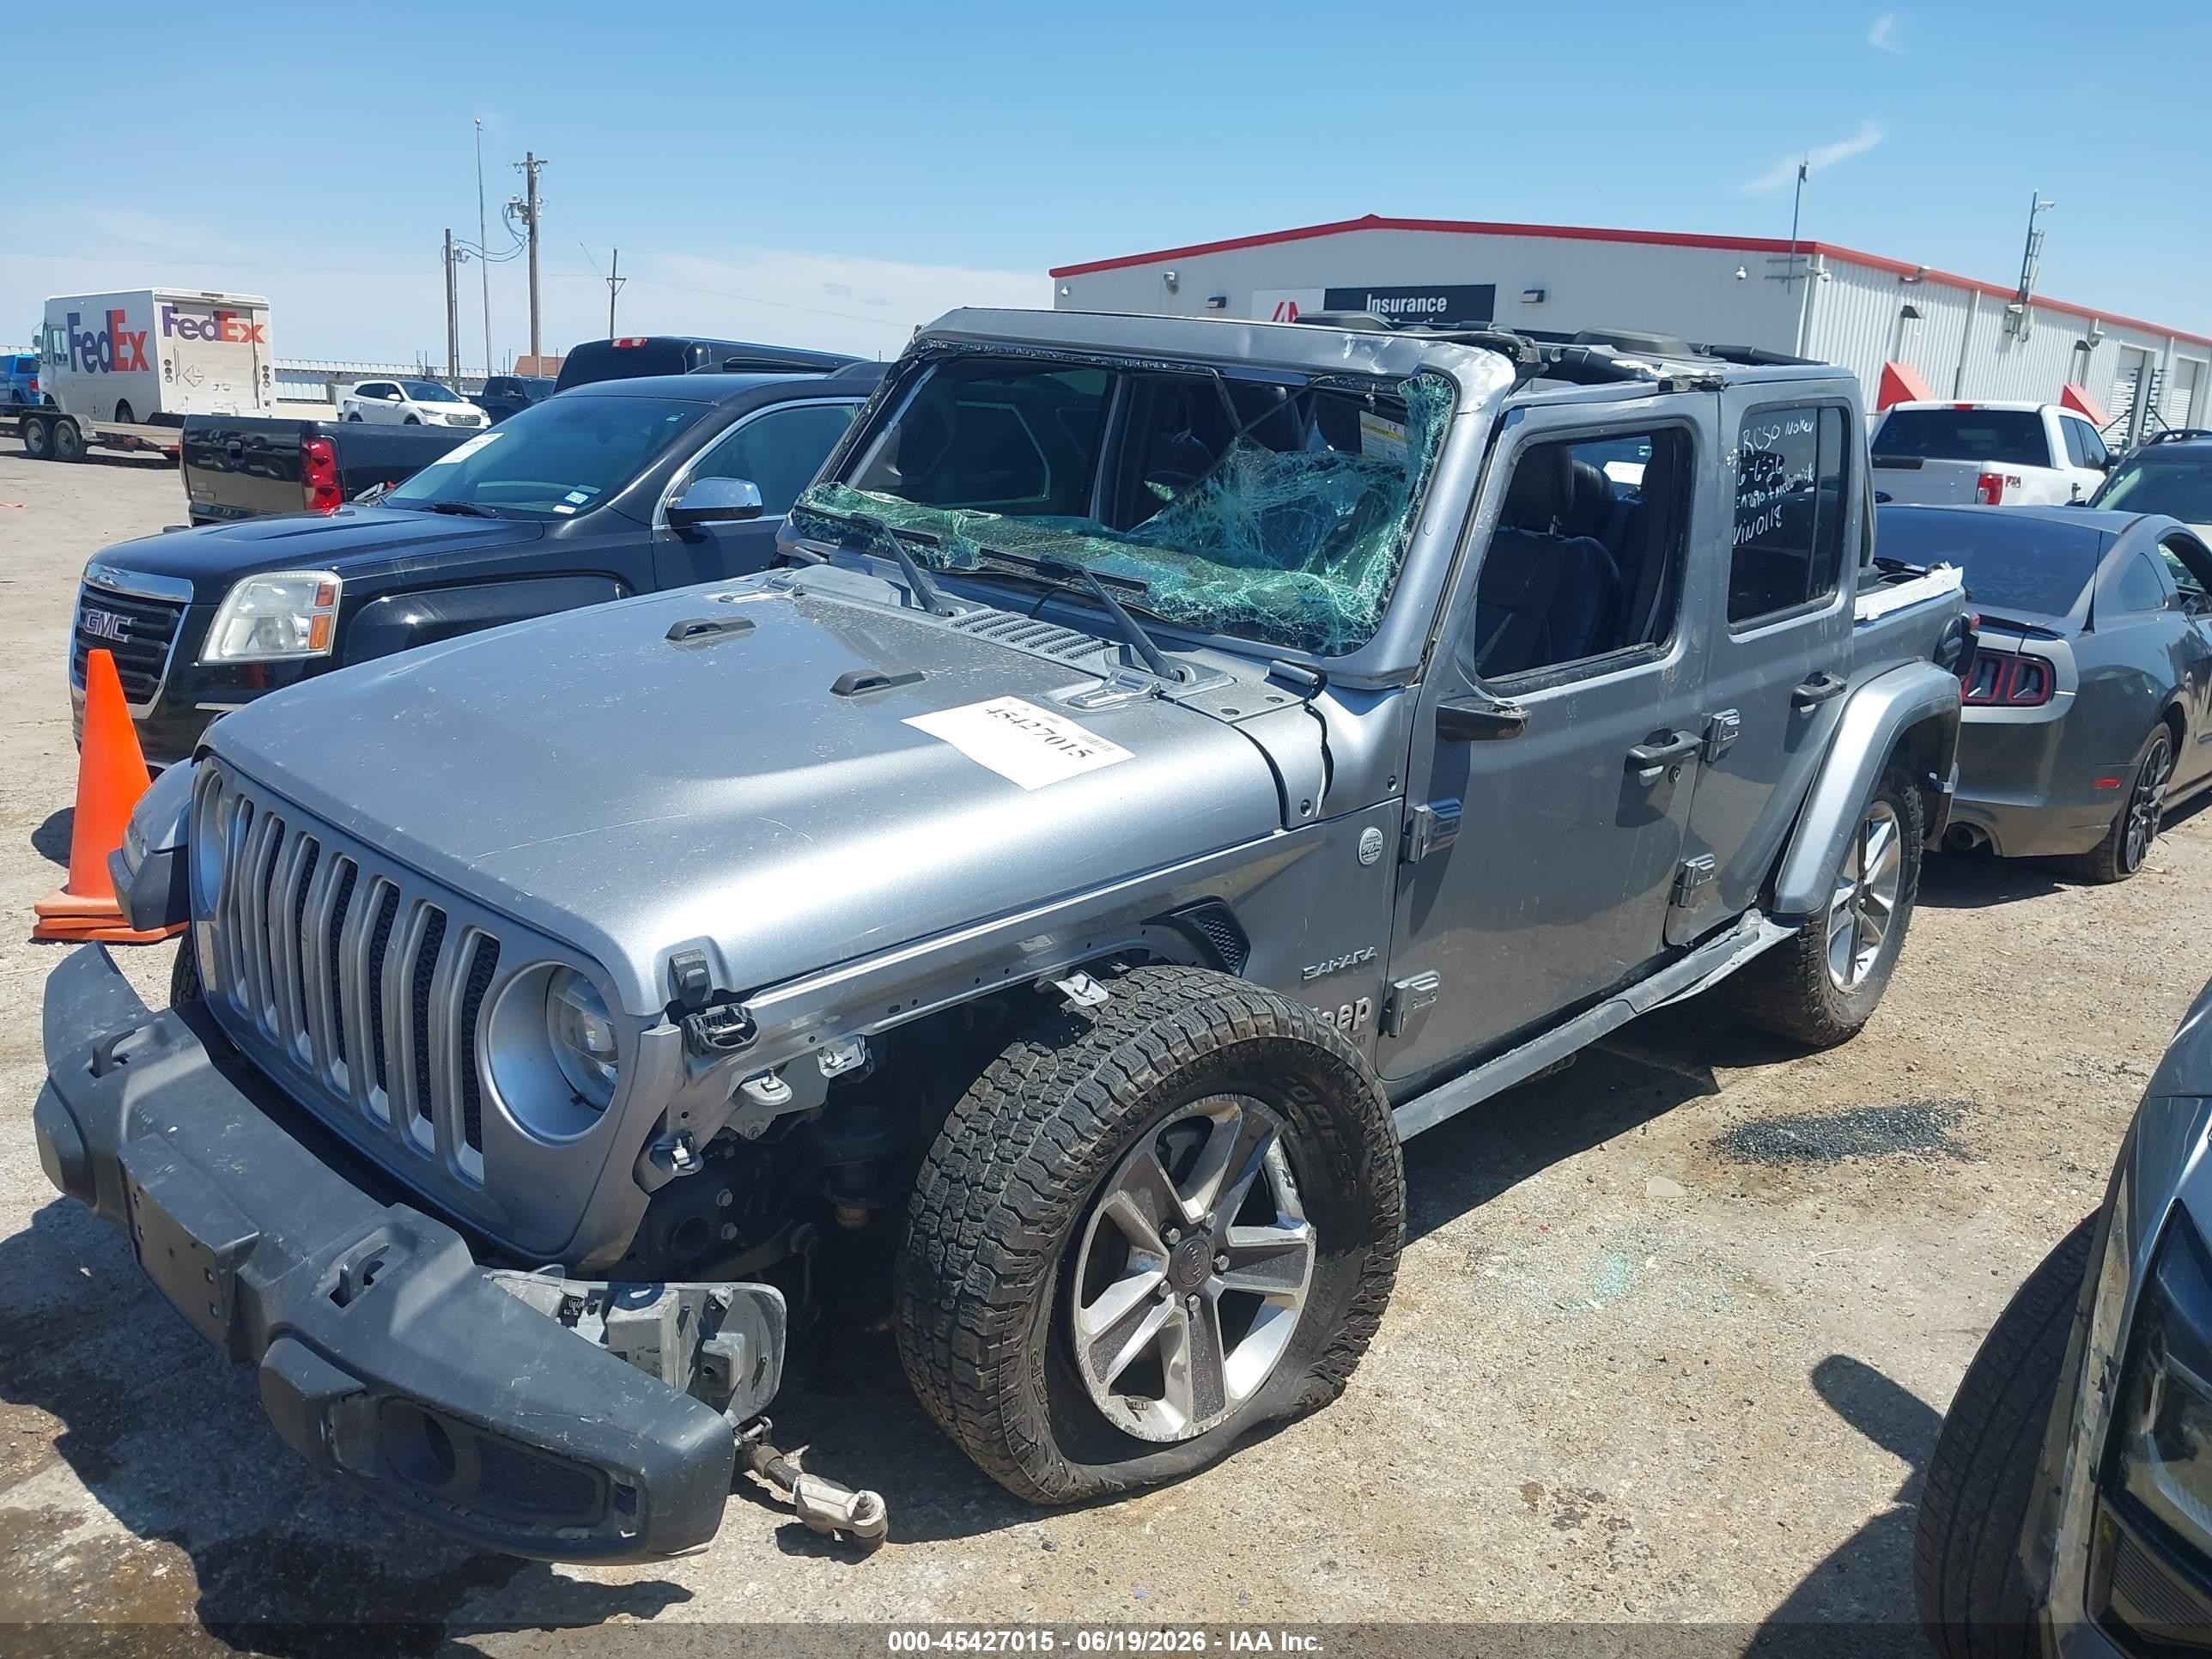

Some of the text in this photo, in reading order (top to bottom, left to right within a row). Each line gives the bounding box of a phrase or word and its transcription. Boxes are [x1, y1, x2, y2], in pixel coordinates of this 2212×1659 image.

[1366, 294, 1448, 313] Insurance
[67, 309, 151, 374] FedEx
[161, 306, 266, 343] FedEx
[1742, 424, 1781, 458] RCSO
[84, 608, 134, 644] GMC
[985, 708, 1095, 758] 45427015
[1302, 946, 1378, 981] SAHARA
[1311, 996, 1372, 1031] eep
